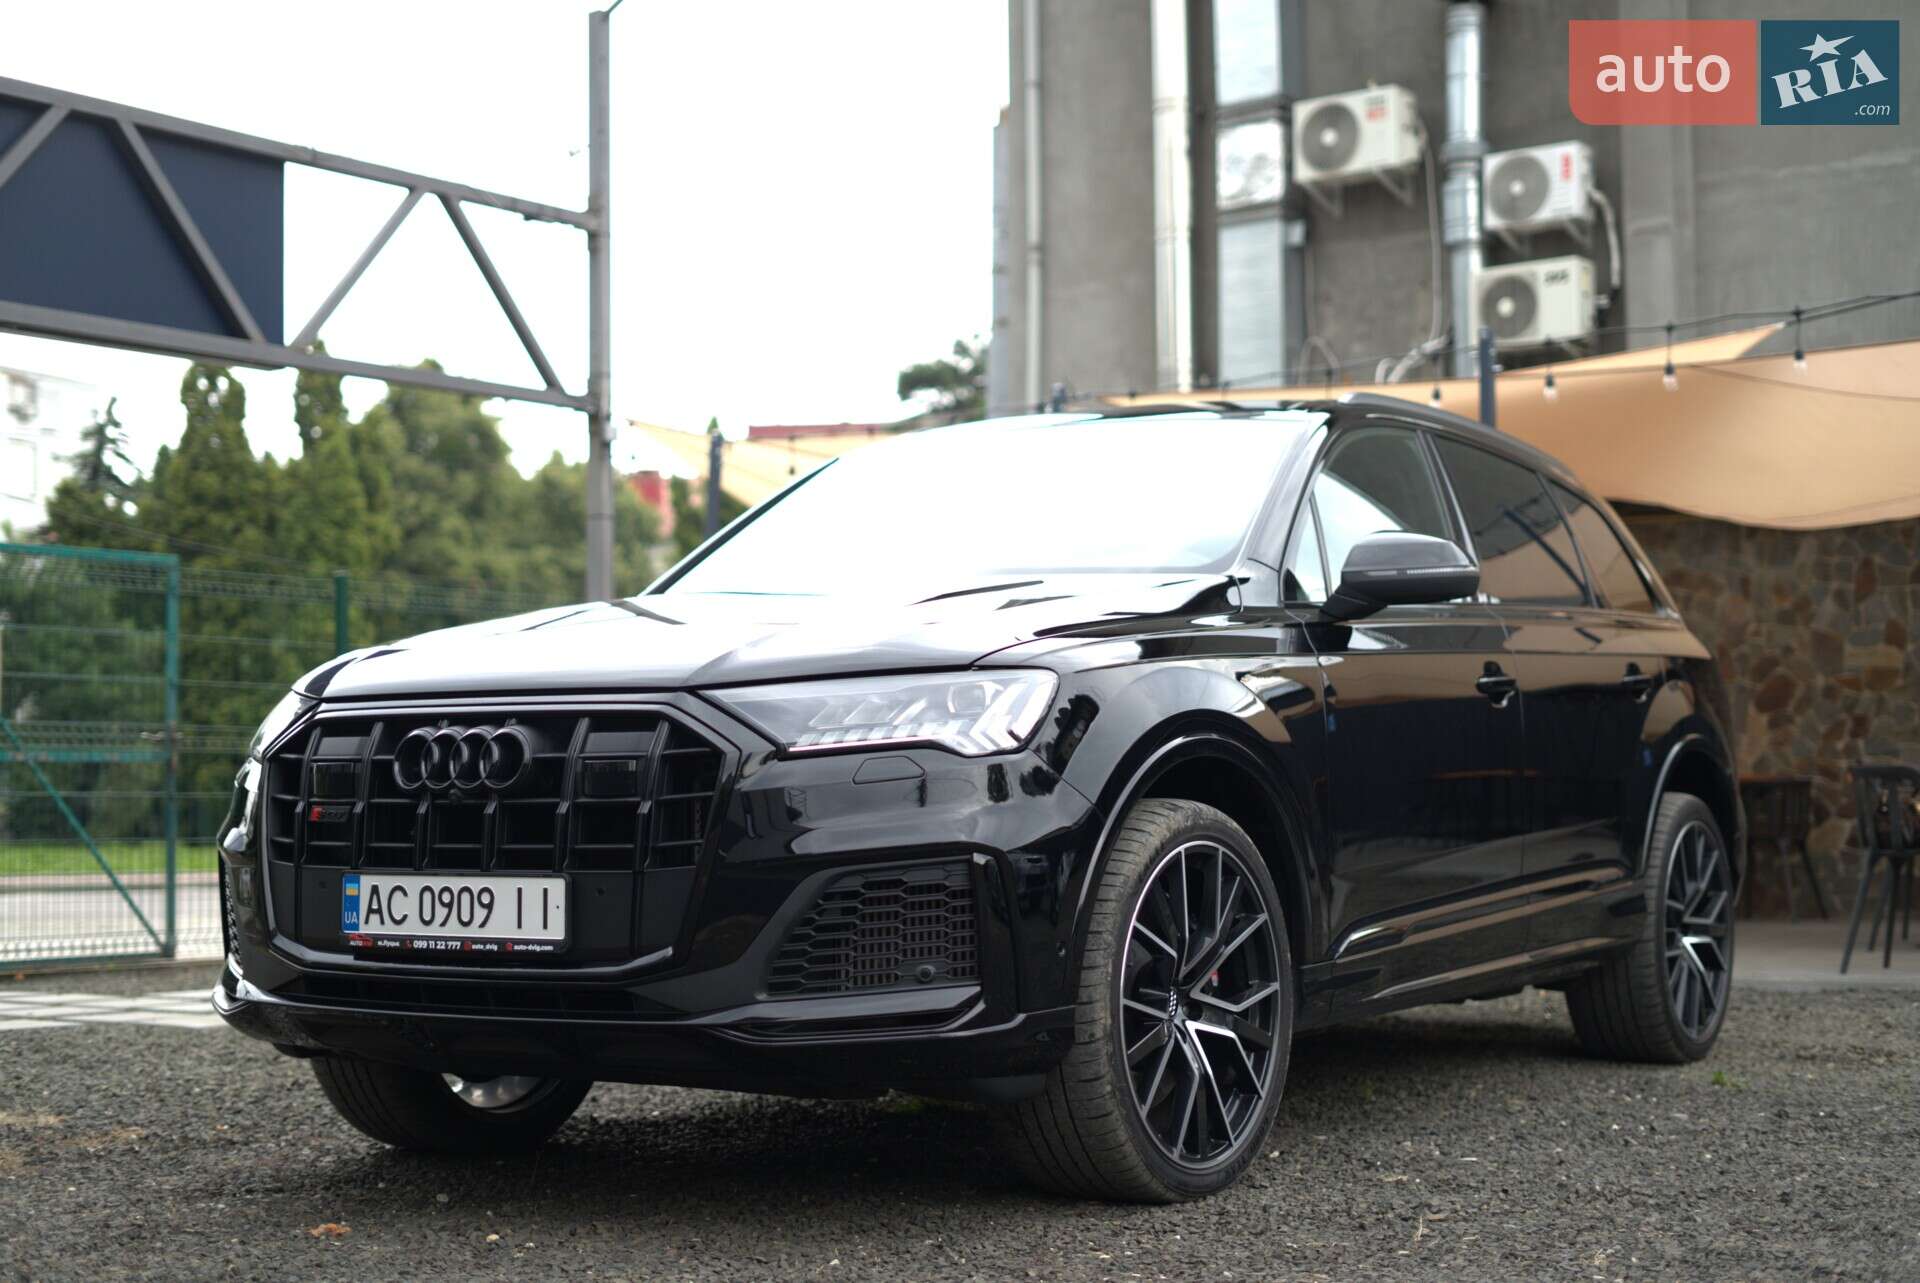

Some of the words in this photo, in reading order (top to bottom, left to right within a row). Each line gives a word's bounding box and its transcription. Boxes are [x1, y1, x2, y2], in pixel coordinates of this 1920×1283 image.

[364, 884, 408, 926] AC
[419, 885, 495, 928] 0909
[344, 912, 359, 924] UA
[413, 940, 427, 949] 099
[429, 941, 435, 949] 11
[436, 941, 446, 949] 22
[447, 942, 461, 950] 777
